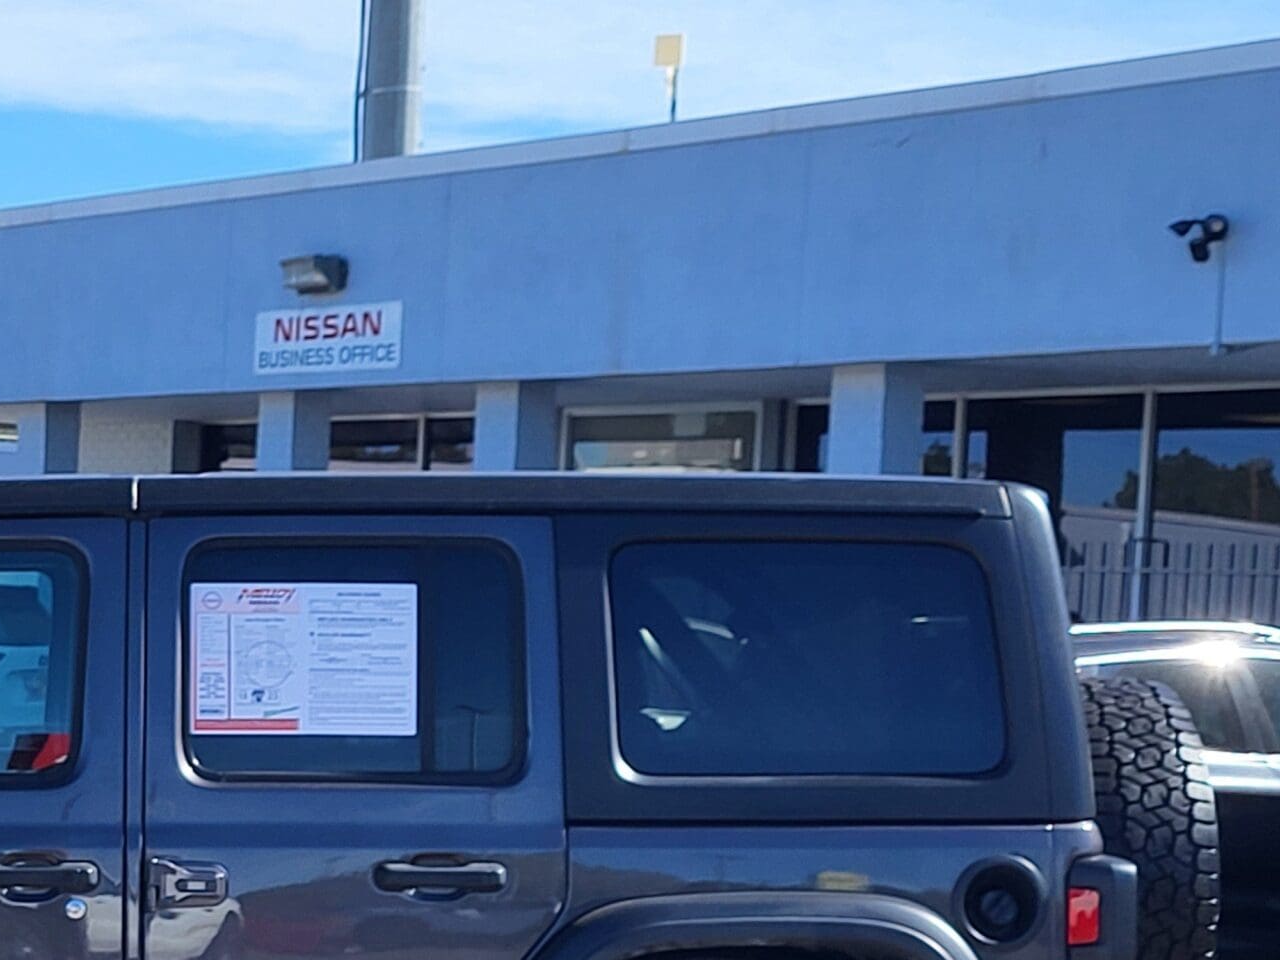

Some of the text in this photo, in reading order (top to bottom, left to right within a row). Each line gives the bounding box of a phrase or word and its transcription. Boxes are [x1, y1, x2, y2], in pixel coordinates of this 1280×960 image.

[274, 310, 383, 343] NISSAN
[258, 343, 397, 369] BUSINESS OFFICE
